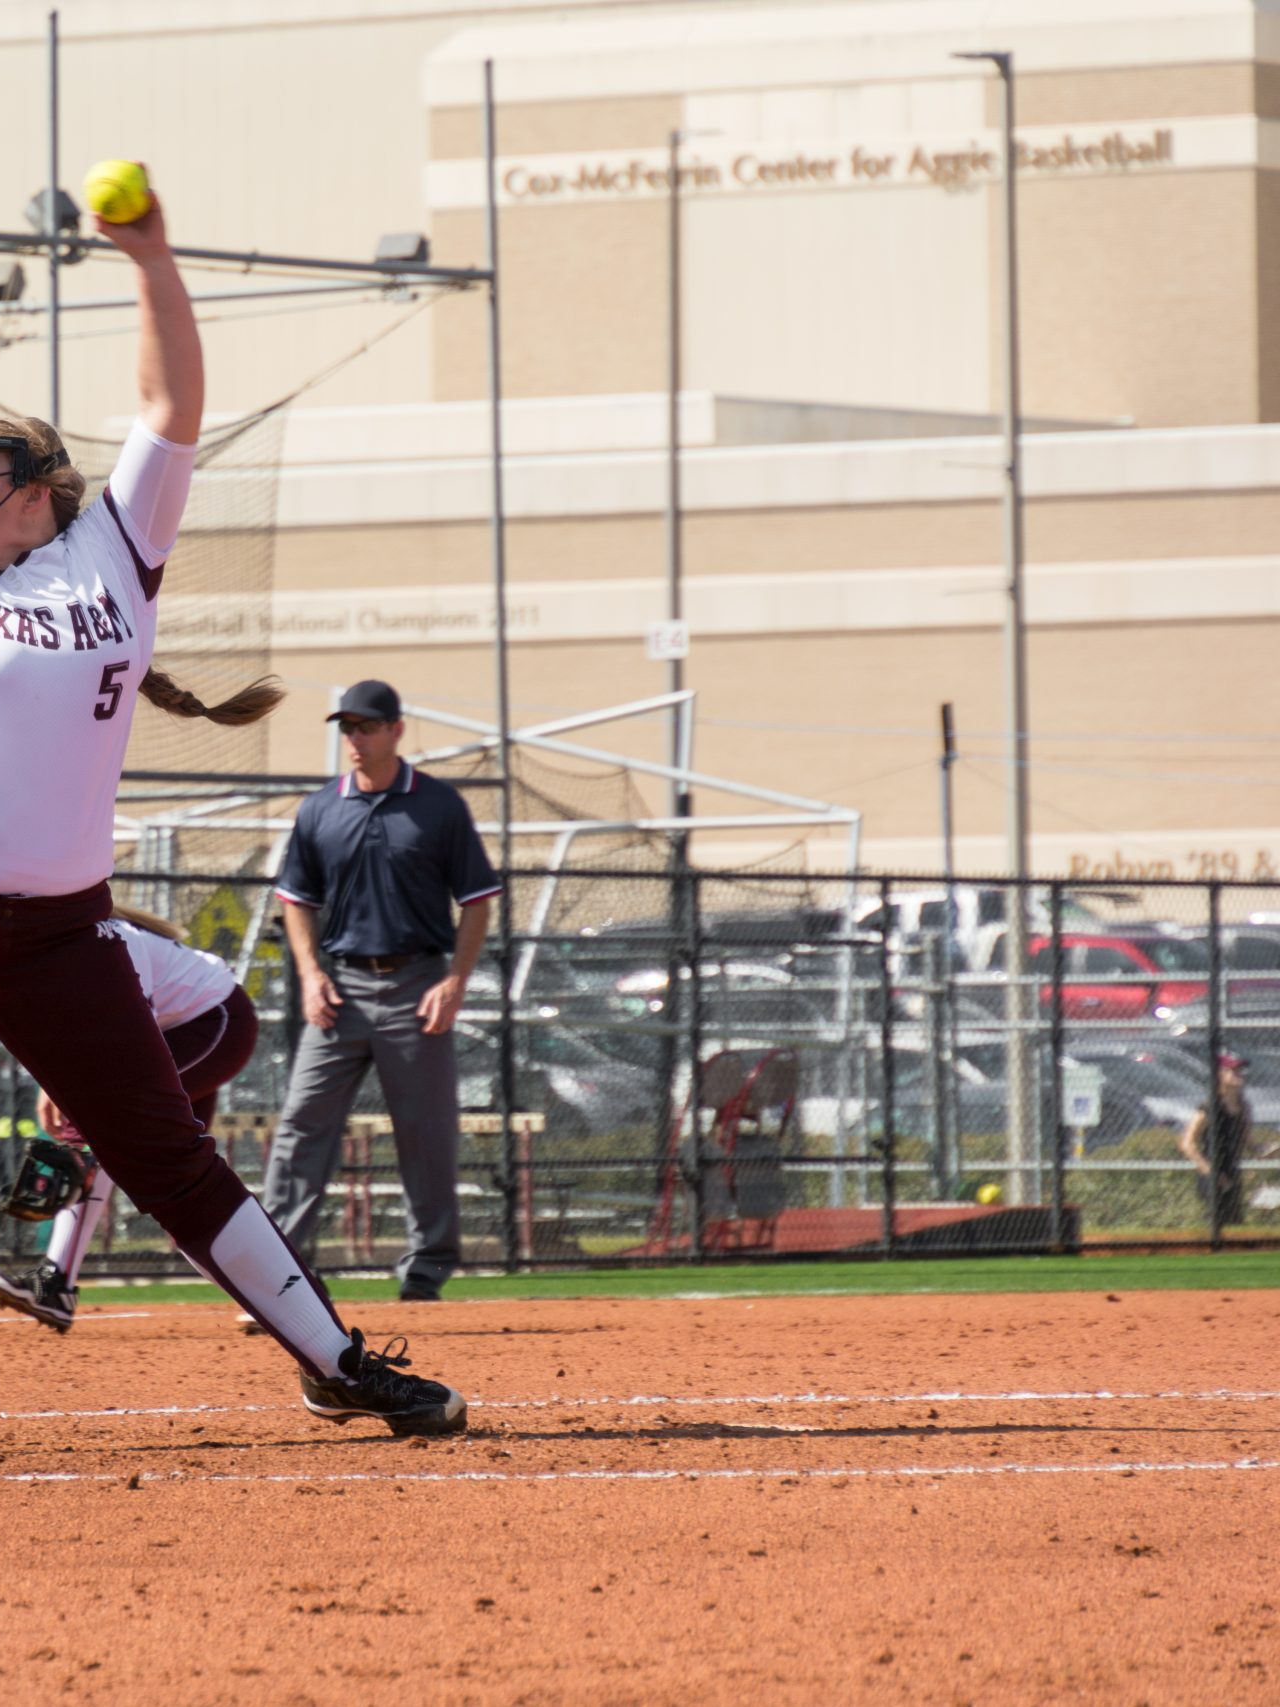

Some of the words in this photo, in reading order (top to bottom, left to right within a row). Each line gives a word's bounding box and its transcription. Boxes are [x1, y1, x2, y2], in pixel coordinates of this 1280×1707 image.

[731, 152, 838, 185] Center
[851, 143, 895, 178] for
[908, 140, 994, 188] Aggie
[66, 584, 134, 651] A&M
[358, 603, 480, 640] Champions
[93, 660, 130, 721] 5
